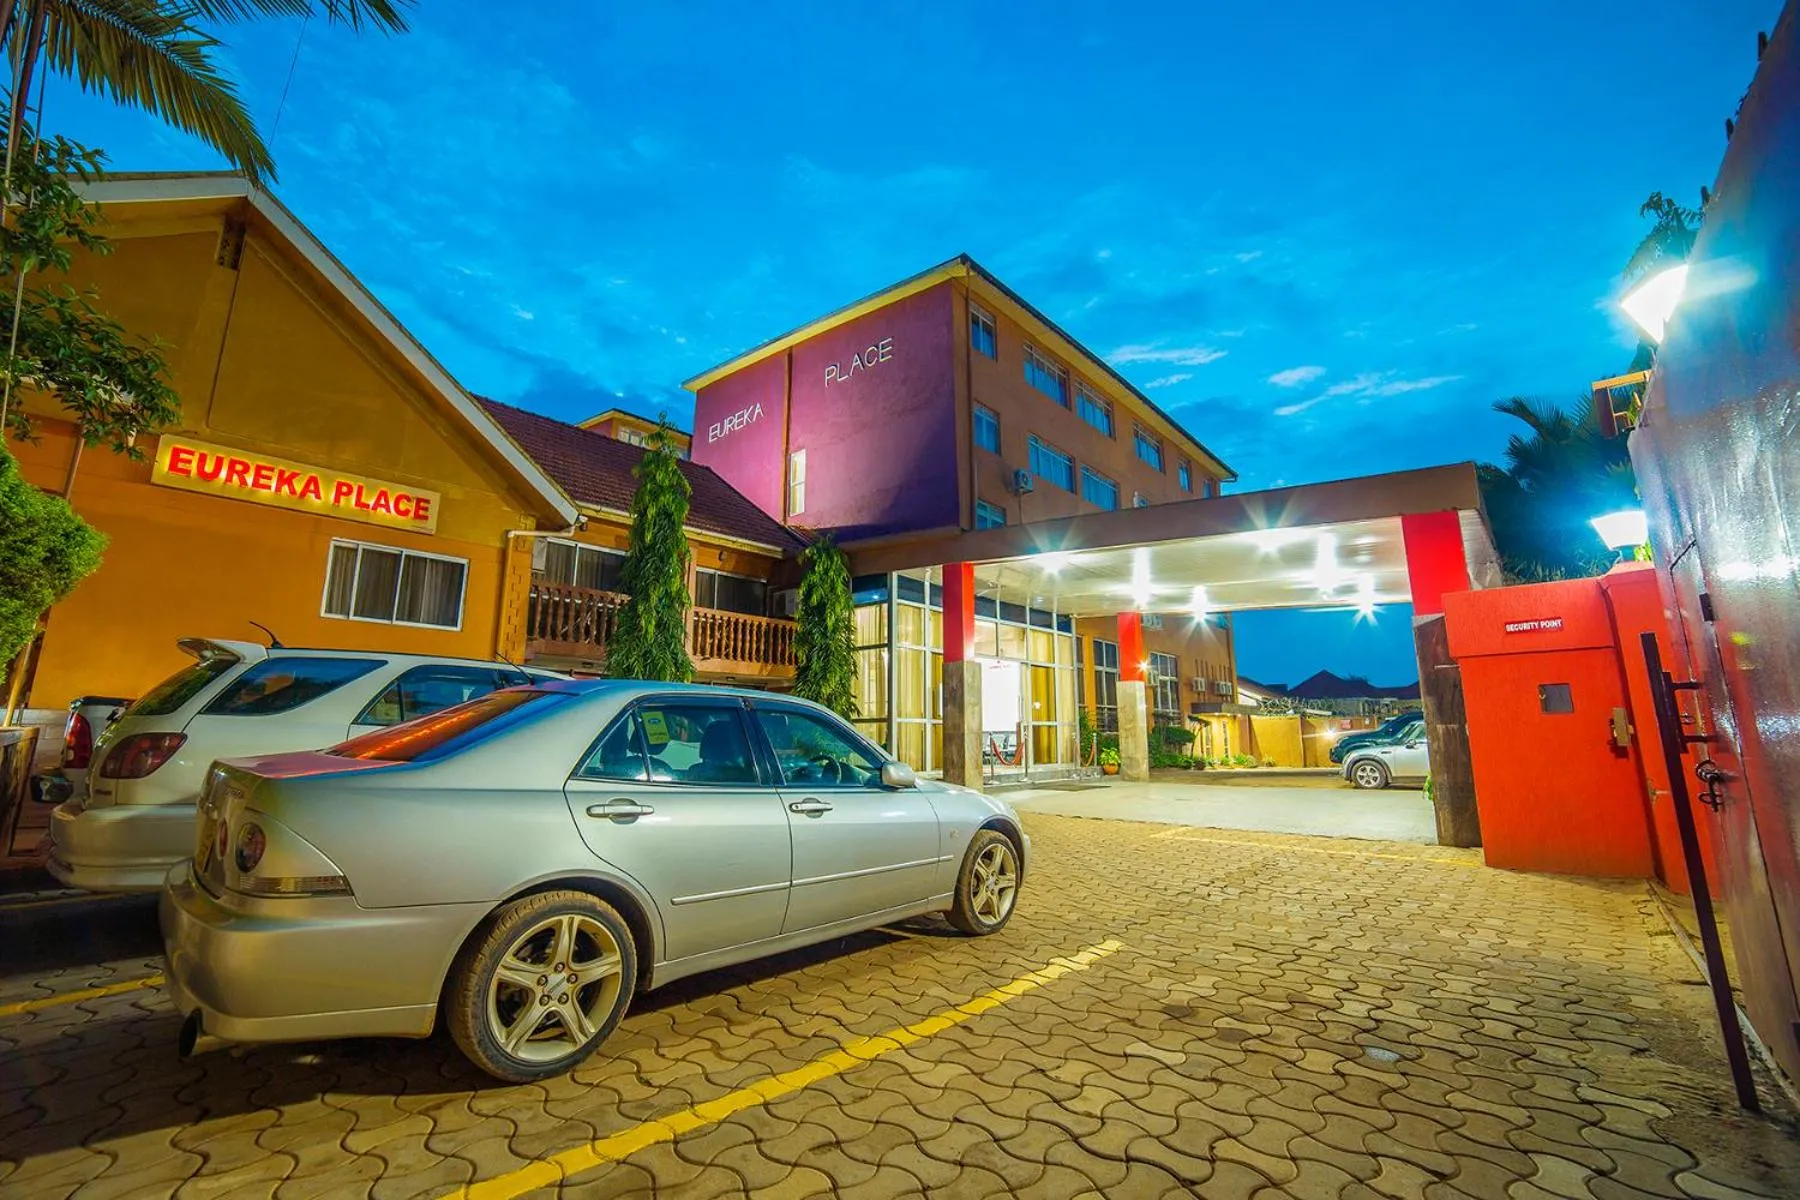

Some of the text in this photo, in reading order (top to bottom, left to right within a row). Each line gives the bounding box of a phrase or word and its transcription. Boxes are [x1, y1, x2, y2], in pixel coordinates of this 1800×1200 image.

[708, 338, 893, 443] EUREKA PLACE
[167, 445, 431, 521] EUREKA PLACE
[1505, 619, 1562, 632] SECURITY POINT
